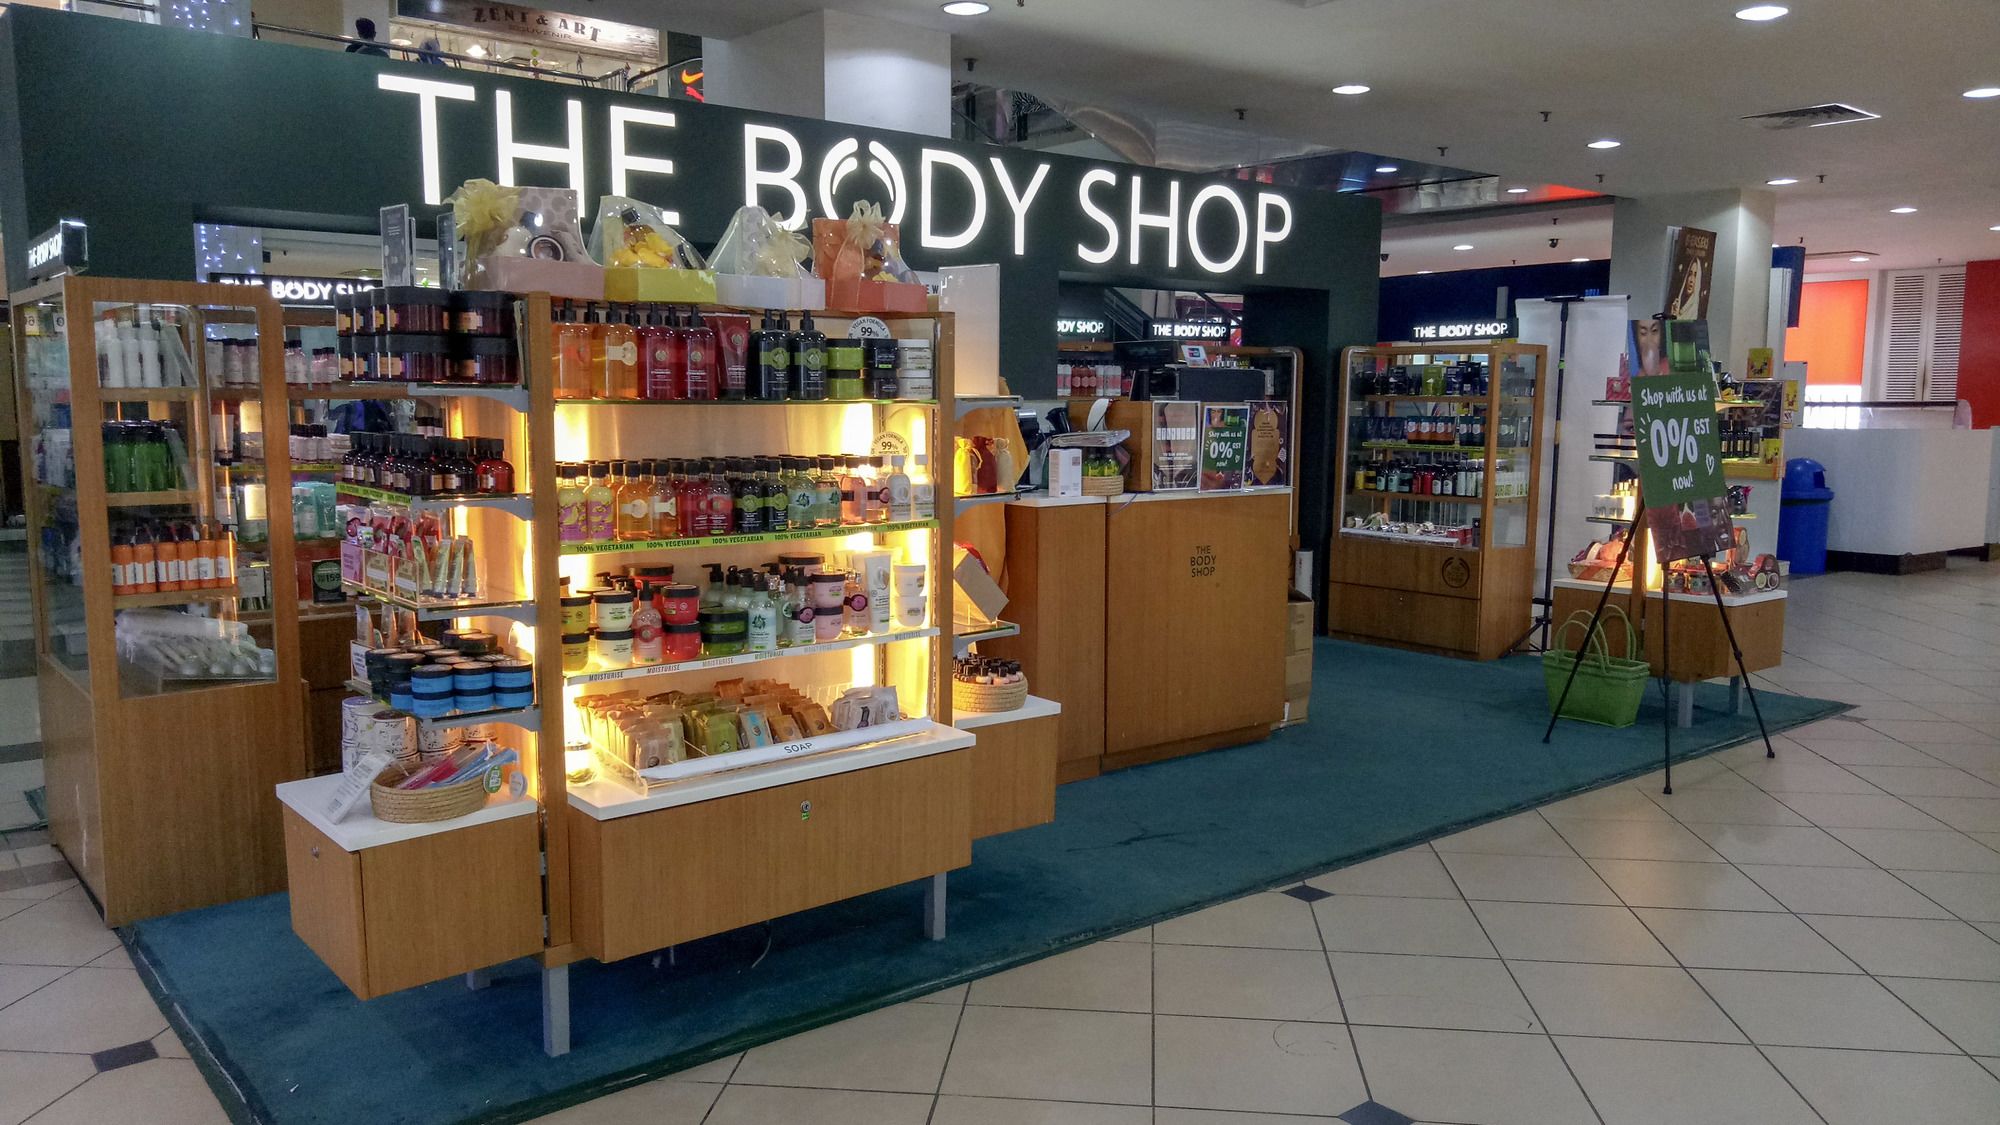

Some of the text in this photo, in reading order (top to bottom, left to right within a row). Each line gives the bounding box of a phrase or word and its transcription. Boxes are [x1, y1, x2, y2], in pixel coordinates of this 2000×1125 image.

[536, 14, 548, 26] &
[559, 18, 601, 42] ART
[377, 73, 1294, 275] THE BODY SHOP
[271, 281, 332, 300] BODY
[861, 326, 879, 338] 99%
[1153, 325, 1167, 336] THE
[1174, 325, 1201, 337] BODY
[1413, 326, 1436, 338] THE
[1439, 324, 1473, 338] BODY
[1641, 384, 1708, 409] Shop with us at
[881, 441, 899, 450] 99%
[1650, 417, 1710, 468] 0% GST
[1210, 441, 1233, 459] 0%
[1672, 469, 1694, 491] now!
[712, 535, 764, 545] 100% VEGETARIAN
[774, 531, 822, 541] 100% VEGETARIAN
[576, 543, 635, 553] 100% VEGETARIAN
[647, 539, 700, 549] 100% VEGETARIAN
[1196, 545, 1211, 555] THE
[1190, 555, 1217, 567] BODY
[1191, 567, 1216, 578] SHOP
[754, 650, 784, 660] MOISTURISE
[702, 657, 734, 667] MOISTURISE
[647, 664, 680, 675] MOISTURISE
[588, 671, 624, 682] MOISTURISE
[784, 742, 812, 754] SOAP
